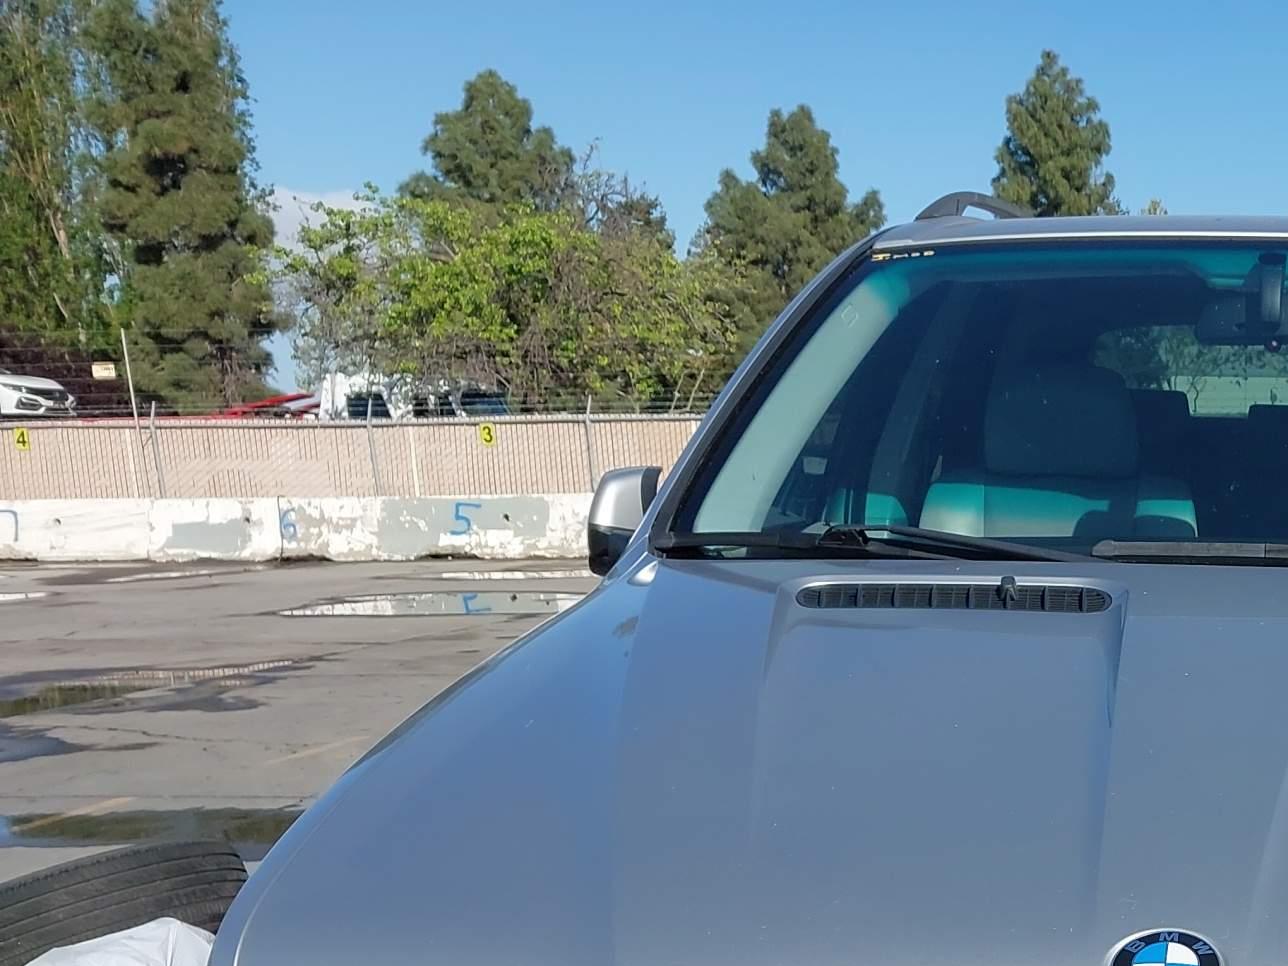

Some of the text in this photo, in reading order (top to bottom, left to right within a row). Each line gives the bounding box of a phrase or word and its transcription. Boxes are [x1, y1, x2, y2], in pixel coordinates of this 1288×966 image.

[16, 431, 27, 447] 4
[482, 426, 493, 443] 3
[281, 508, 297, 540] 6
[450, 502, 482, 535] 5
[1124, 932, 1214, 956] BMW
